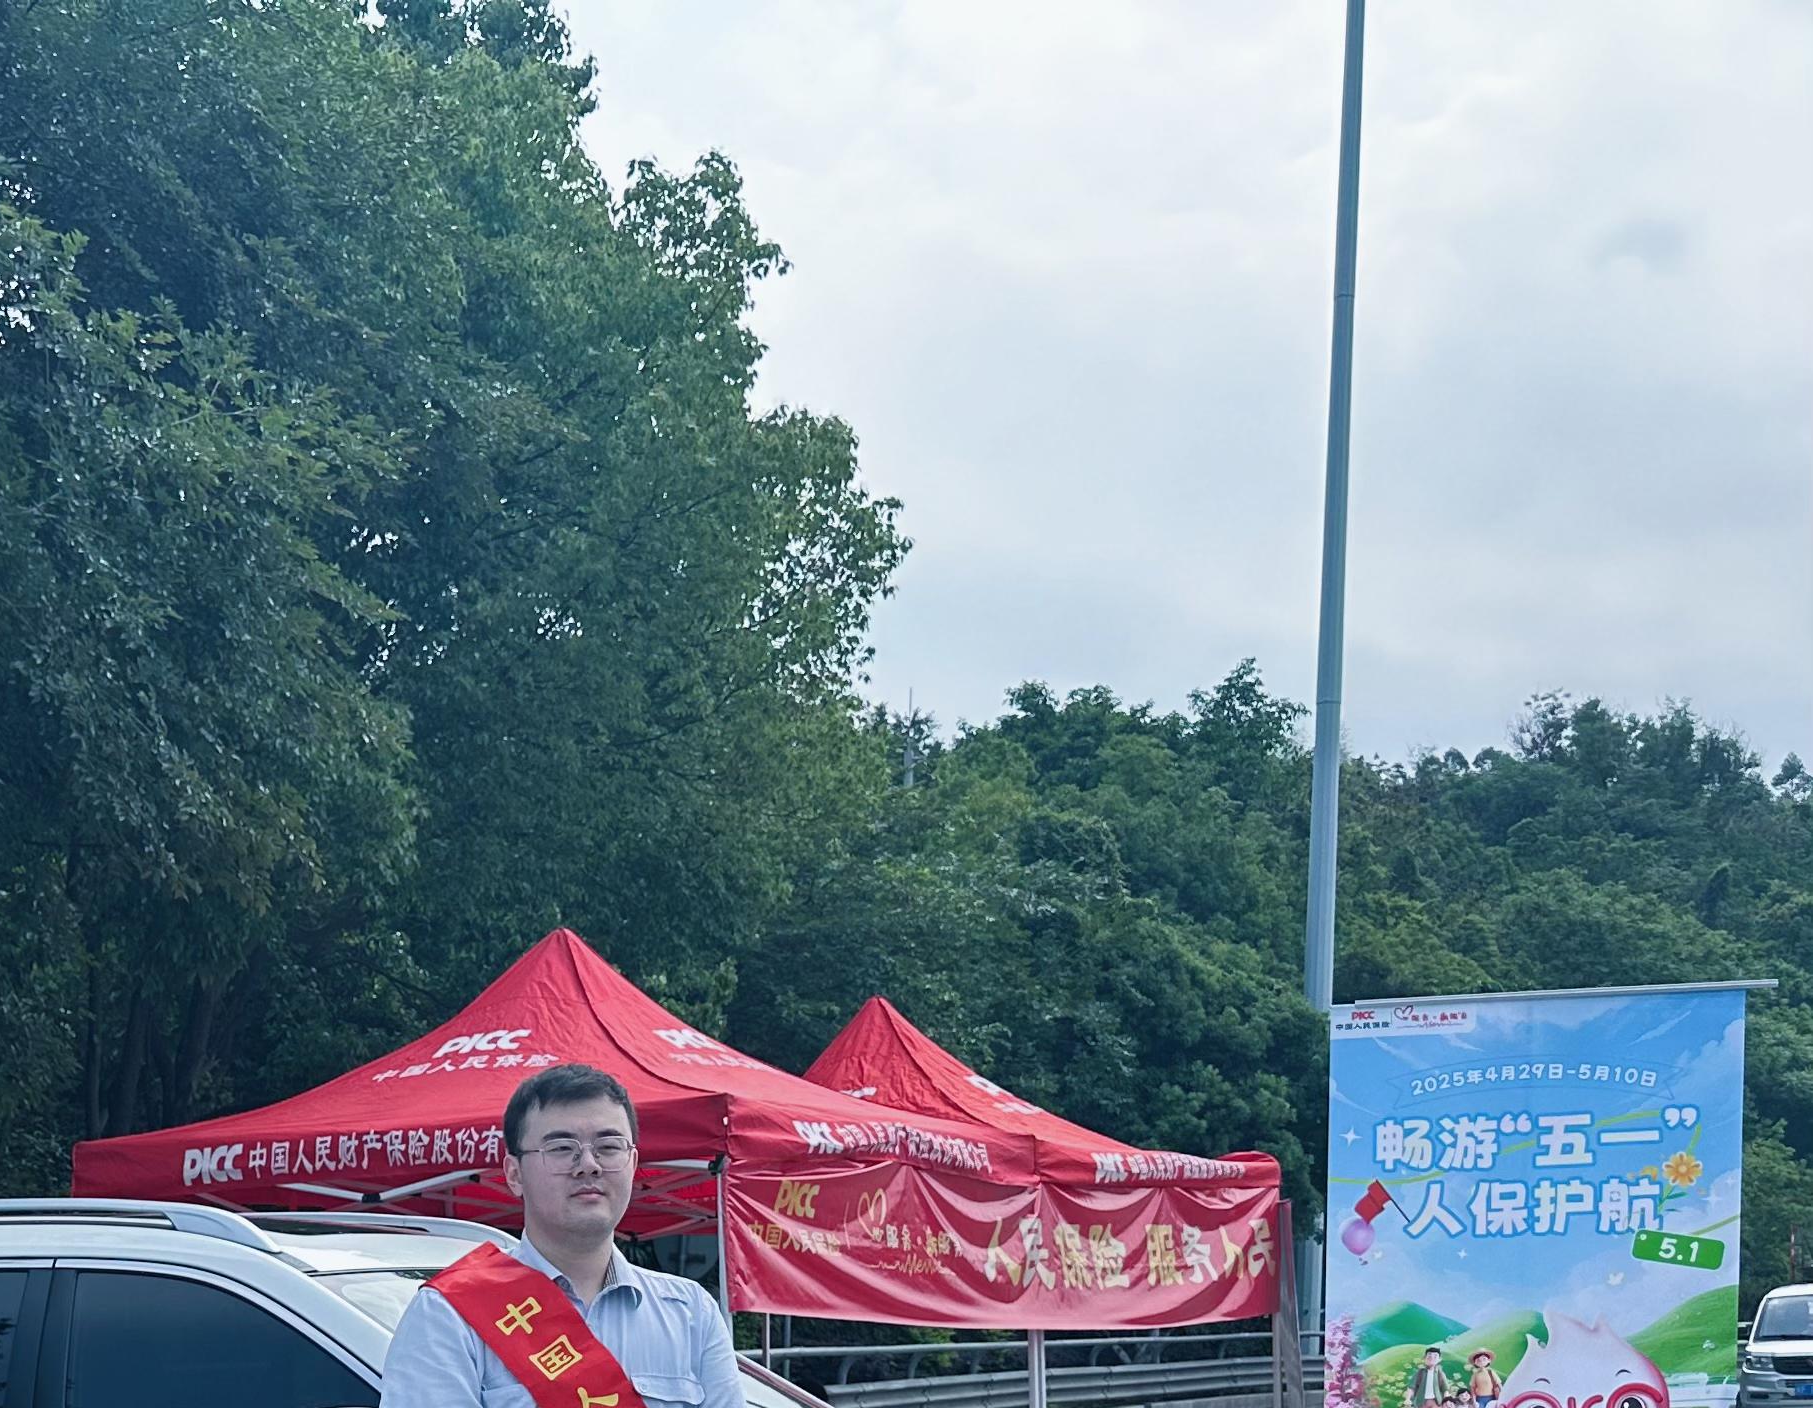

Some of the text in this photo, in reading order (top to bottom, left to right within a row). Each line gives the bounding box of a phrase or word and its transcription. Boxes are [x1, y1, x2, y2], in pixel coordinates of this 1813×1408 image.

[433, 1029, 531, 1058] PICC
[372, 1054, 559, 1082] 中国人民保险
[1410, 1063, 1658, 1096] 2025年4月29日-5月10日
[183, 1143, 243, 1186] PICC
[773, 1179, 820, 1219] PICC
[1406, 1178, 1660, 1236] 人保护航
[1659, 1237, 1699, 1262] 5.1
